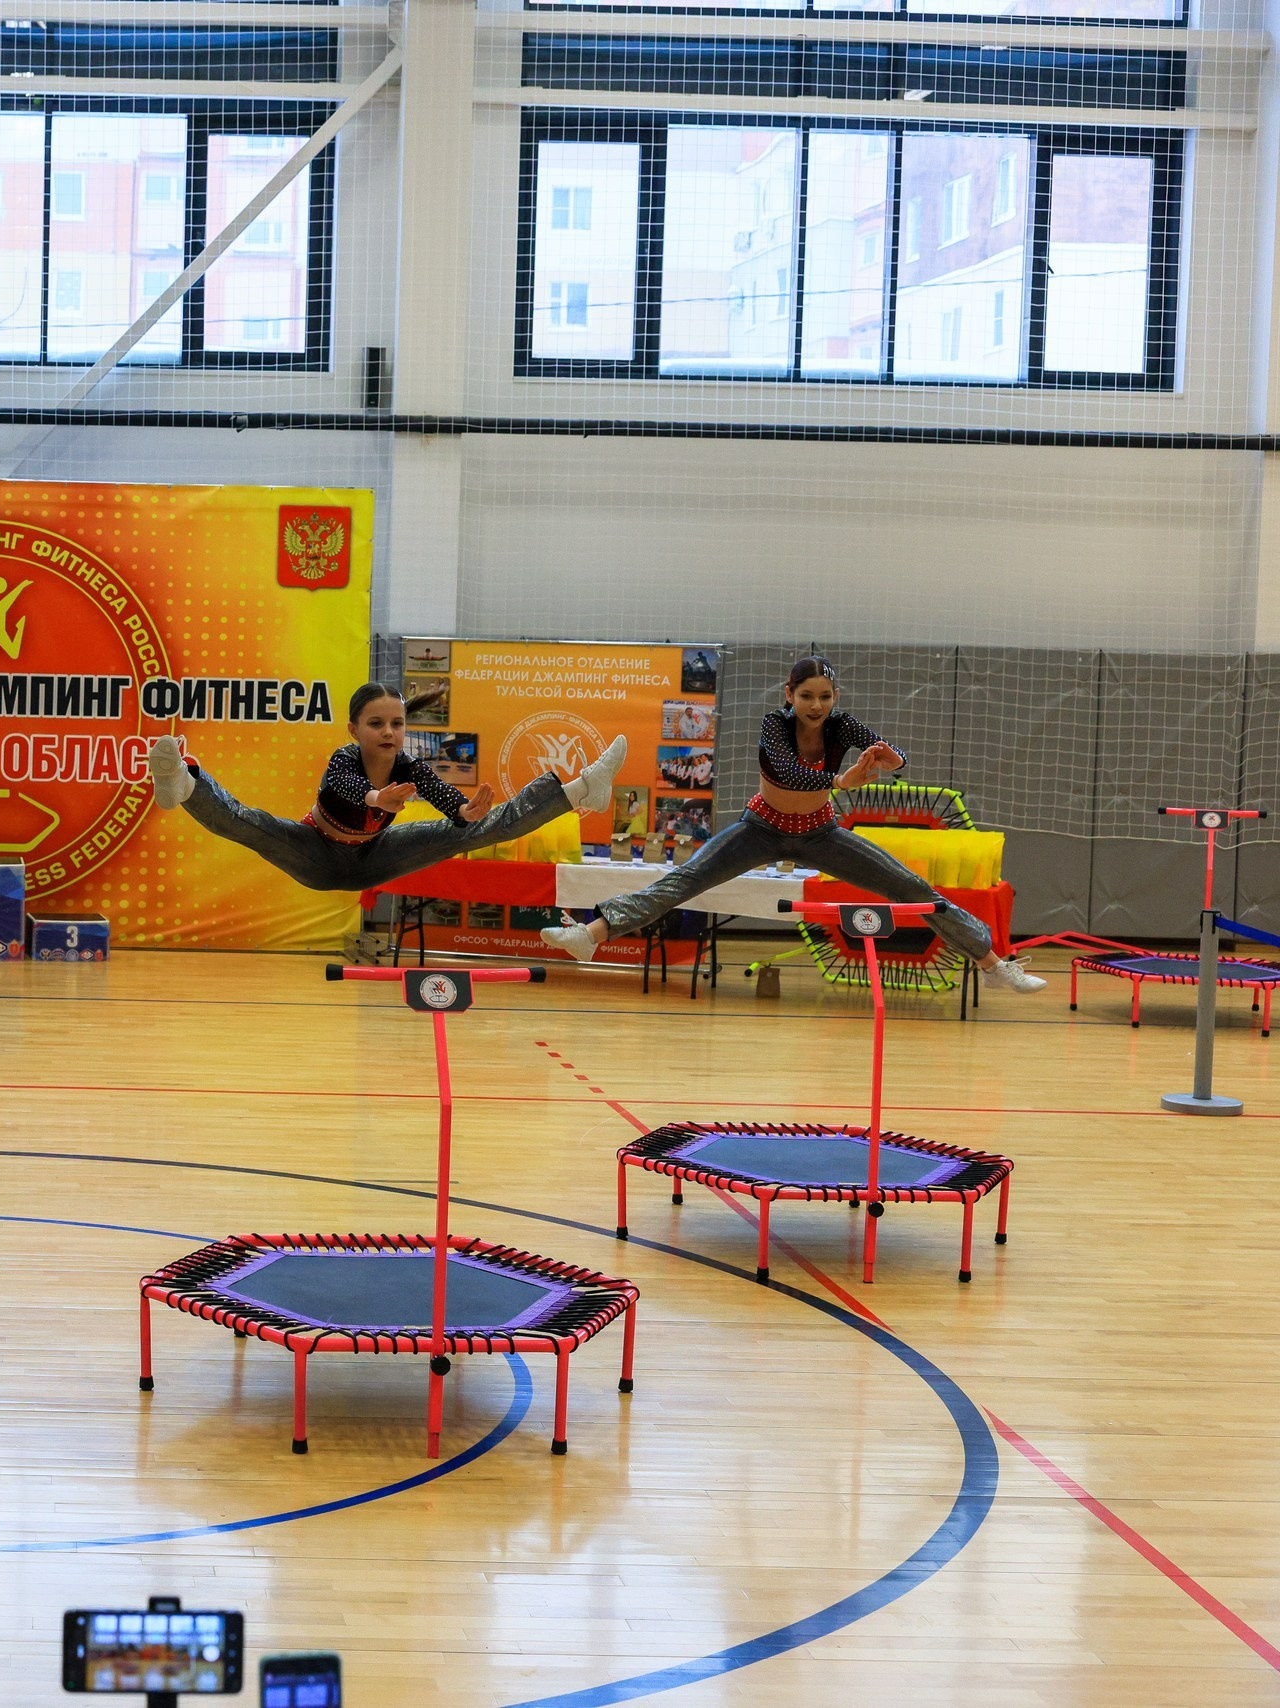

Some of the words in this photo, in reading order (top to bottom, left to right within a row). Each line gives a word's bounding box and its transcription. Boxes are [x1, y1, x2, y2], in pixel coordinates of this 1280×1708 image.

[31, 540, 128, 615] ФИТНЕСА
[123, 614, 161, 680] РОСС
[475, 654, 573, 667] РЕГИОНАЛЬНОЕ
[577, 657, 650, 670] ОТДЕЛЕНИЕ
[454, 669, 529, 682] ФЕДЕРАЦИИ
[532, 671, 608, 684] ДЖАМПИНГ
[611, 673, 670, 686] ФИТНЕСА
[141, 676, 334, 723] ФИТНЕСА
[496, 685, 562, 698] ТУЛЬСКОЙ
[566, 687, 626, 700] ОБЛАСТИ
[1, 733, 200, 784] ОБЛАС
[66, 926, 78, 947] 3
